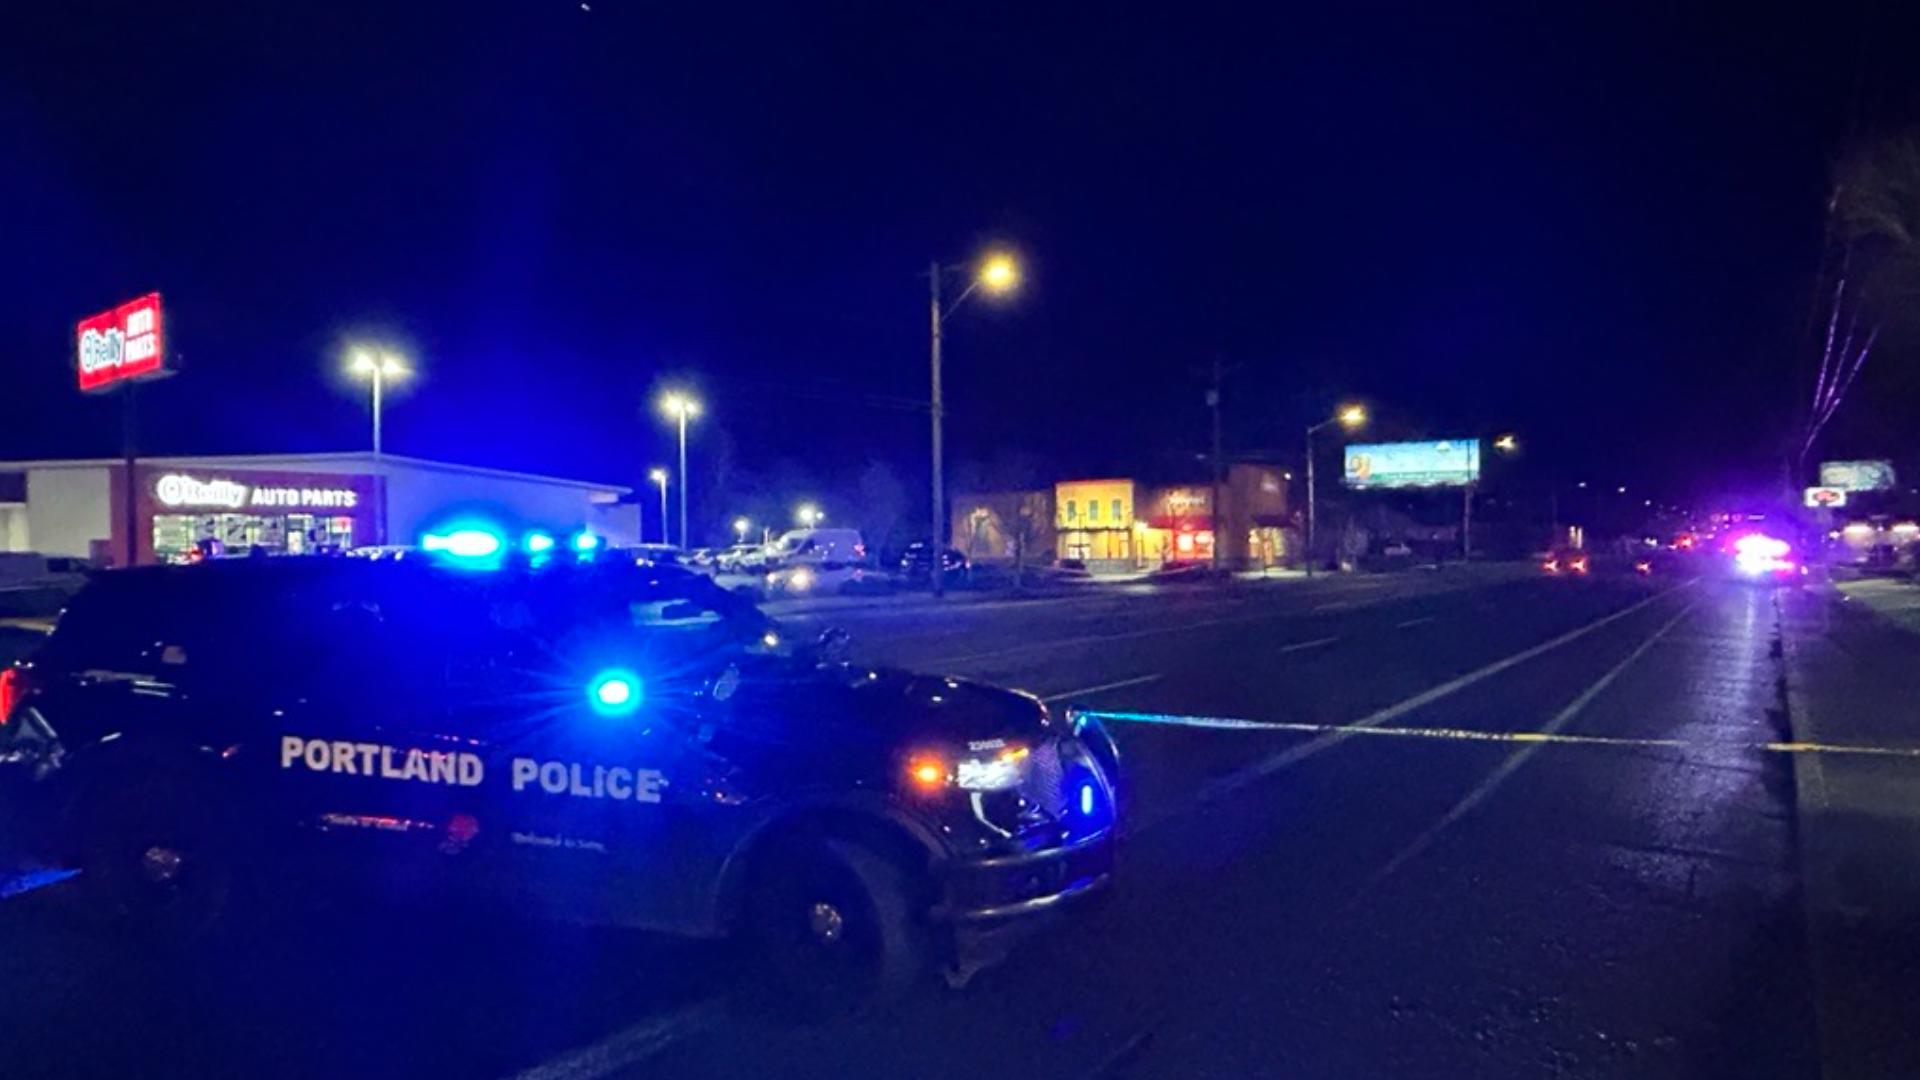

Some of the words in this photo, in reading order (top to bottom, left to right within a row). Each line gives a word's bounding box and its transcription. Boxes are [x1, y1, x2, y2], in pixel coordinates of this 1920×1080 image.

[251, 488, 300, 506] AUTO
[302, 489, 357, 507] PARTS
[281, 735, 484, 787] PORTLAND
[512, 757, 662, 803] POLICE
